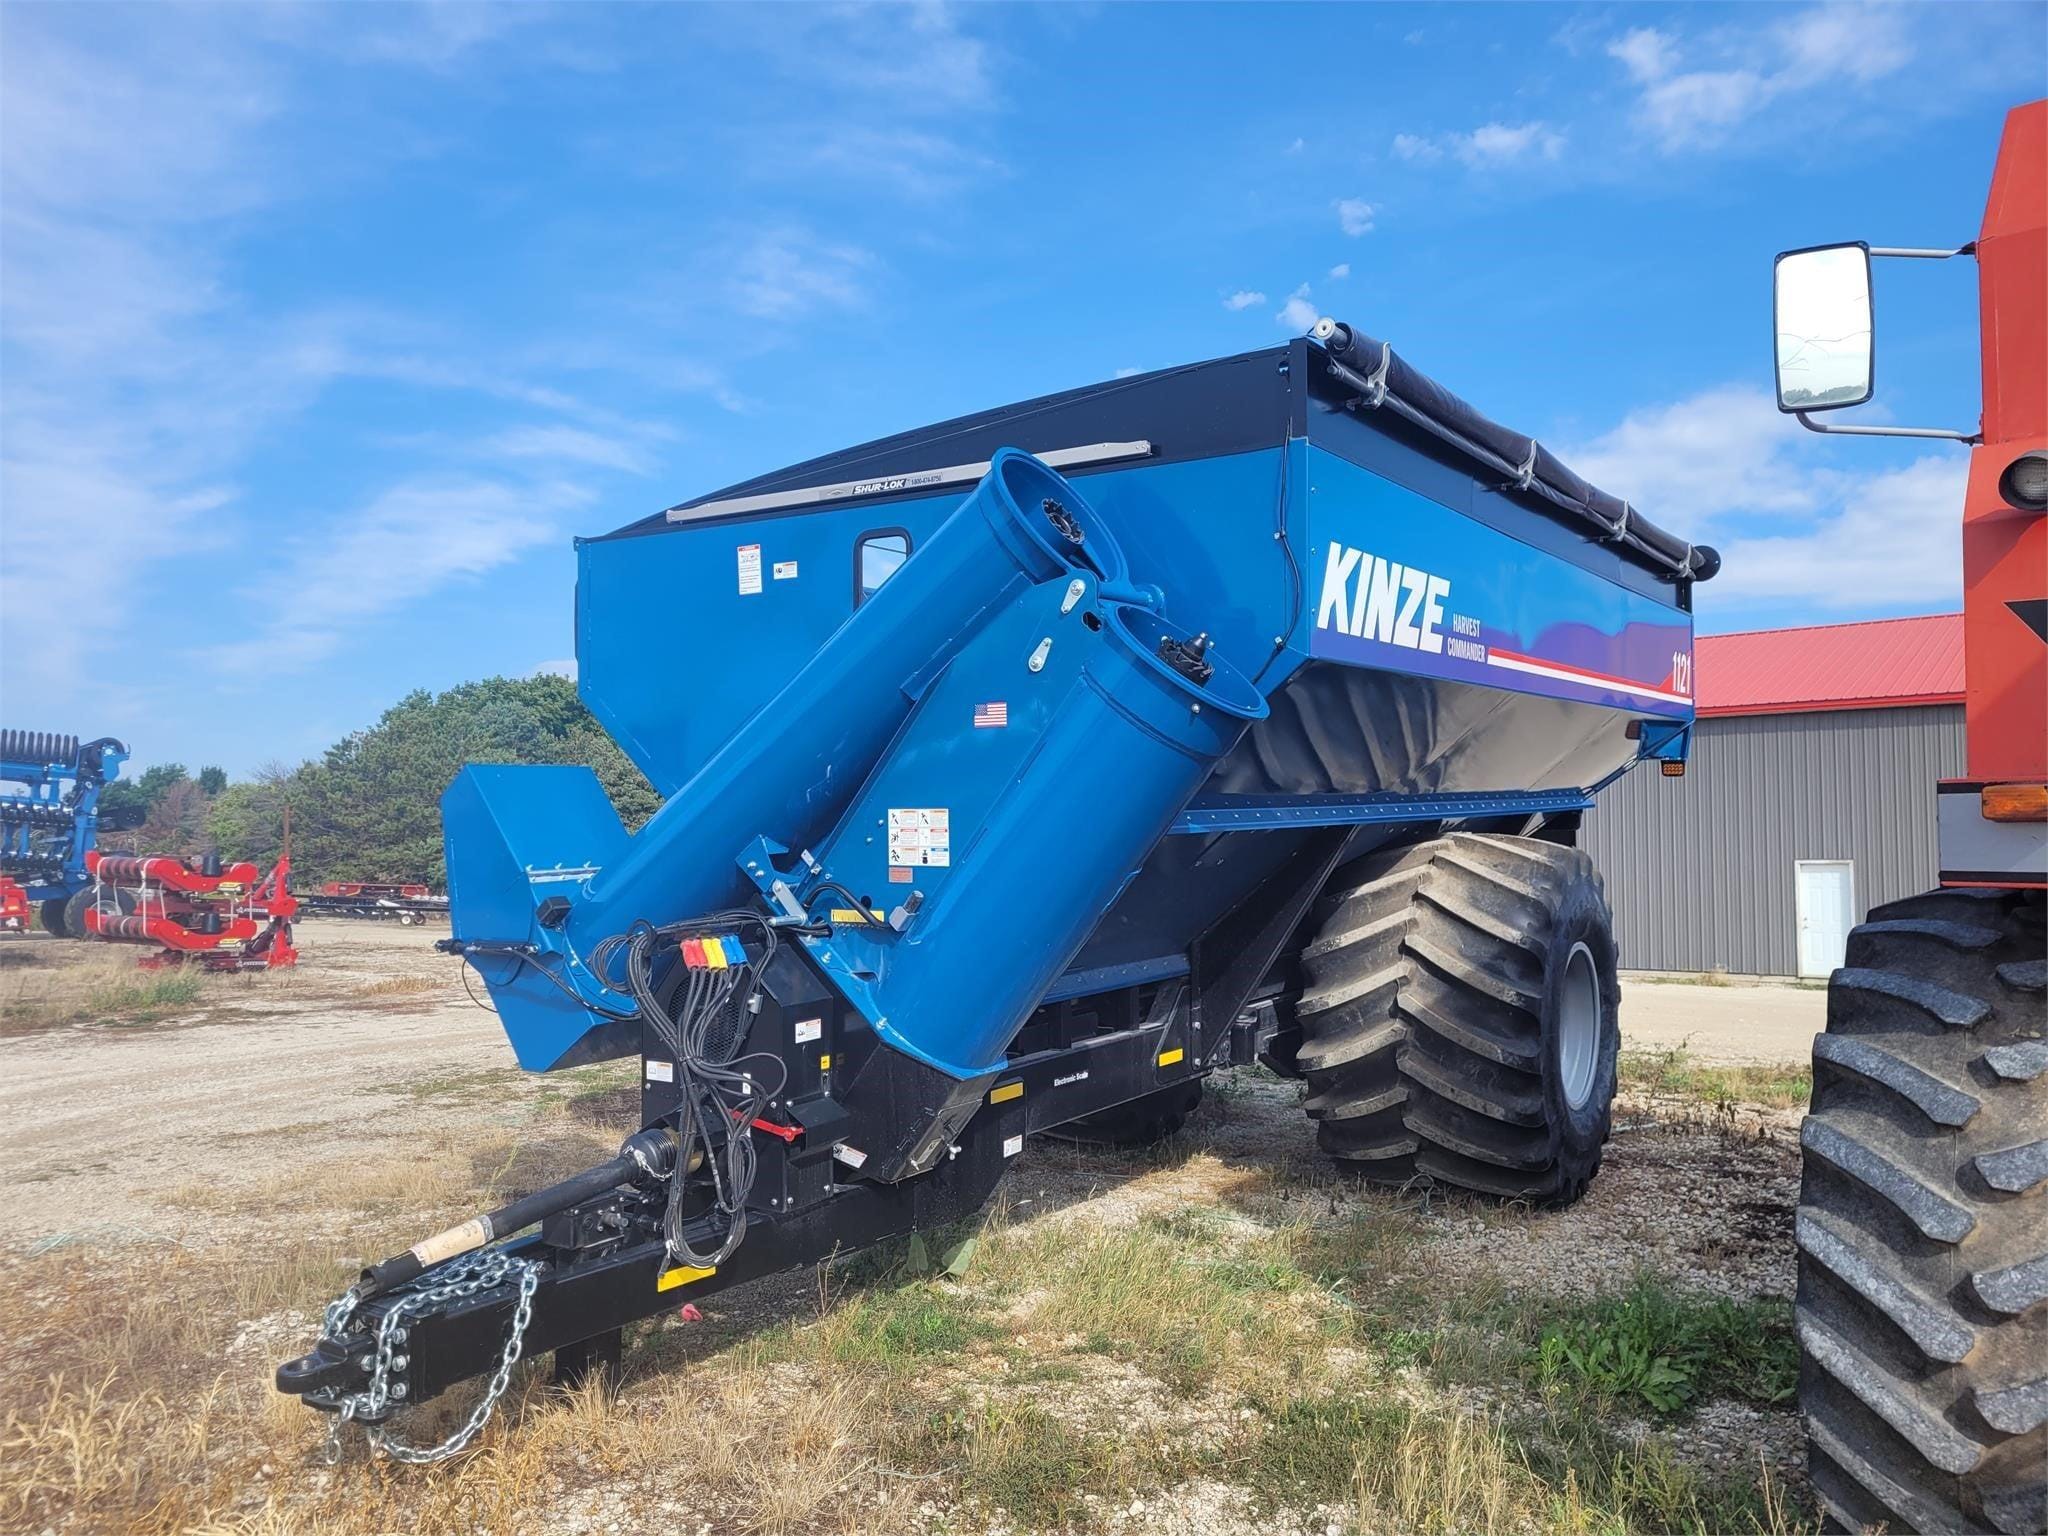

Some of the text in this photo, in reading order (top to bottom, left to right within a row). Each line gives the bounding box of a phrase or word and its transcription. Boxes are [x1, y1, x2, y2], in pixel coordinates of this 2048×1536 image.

[854, 480, 904, 494] SHUR-LOK
[1317, 541, 1451, 654] KINZE
[1453, 613, 1480, 638] HARVEST
[1447, 637, 1486, 663] COMMANDER
[1673, 651, 1691, 694] 1121
